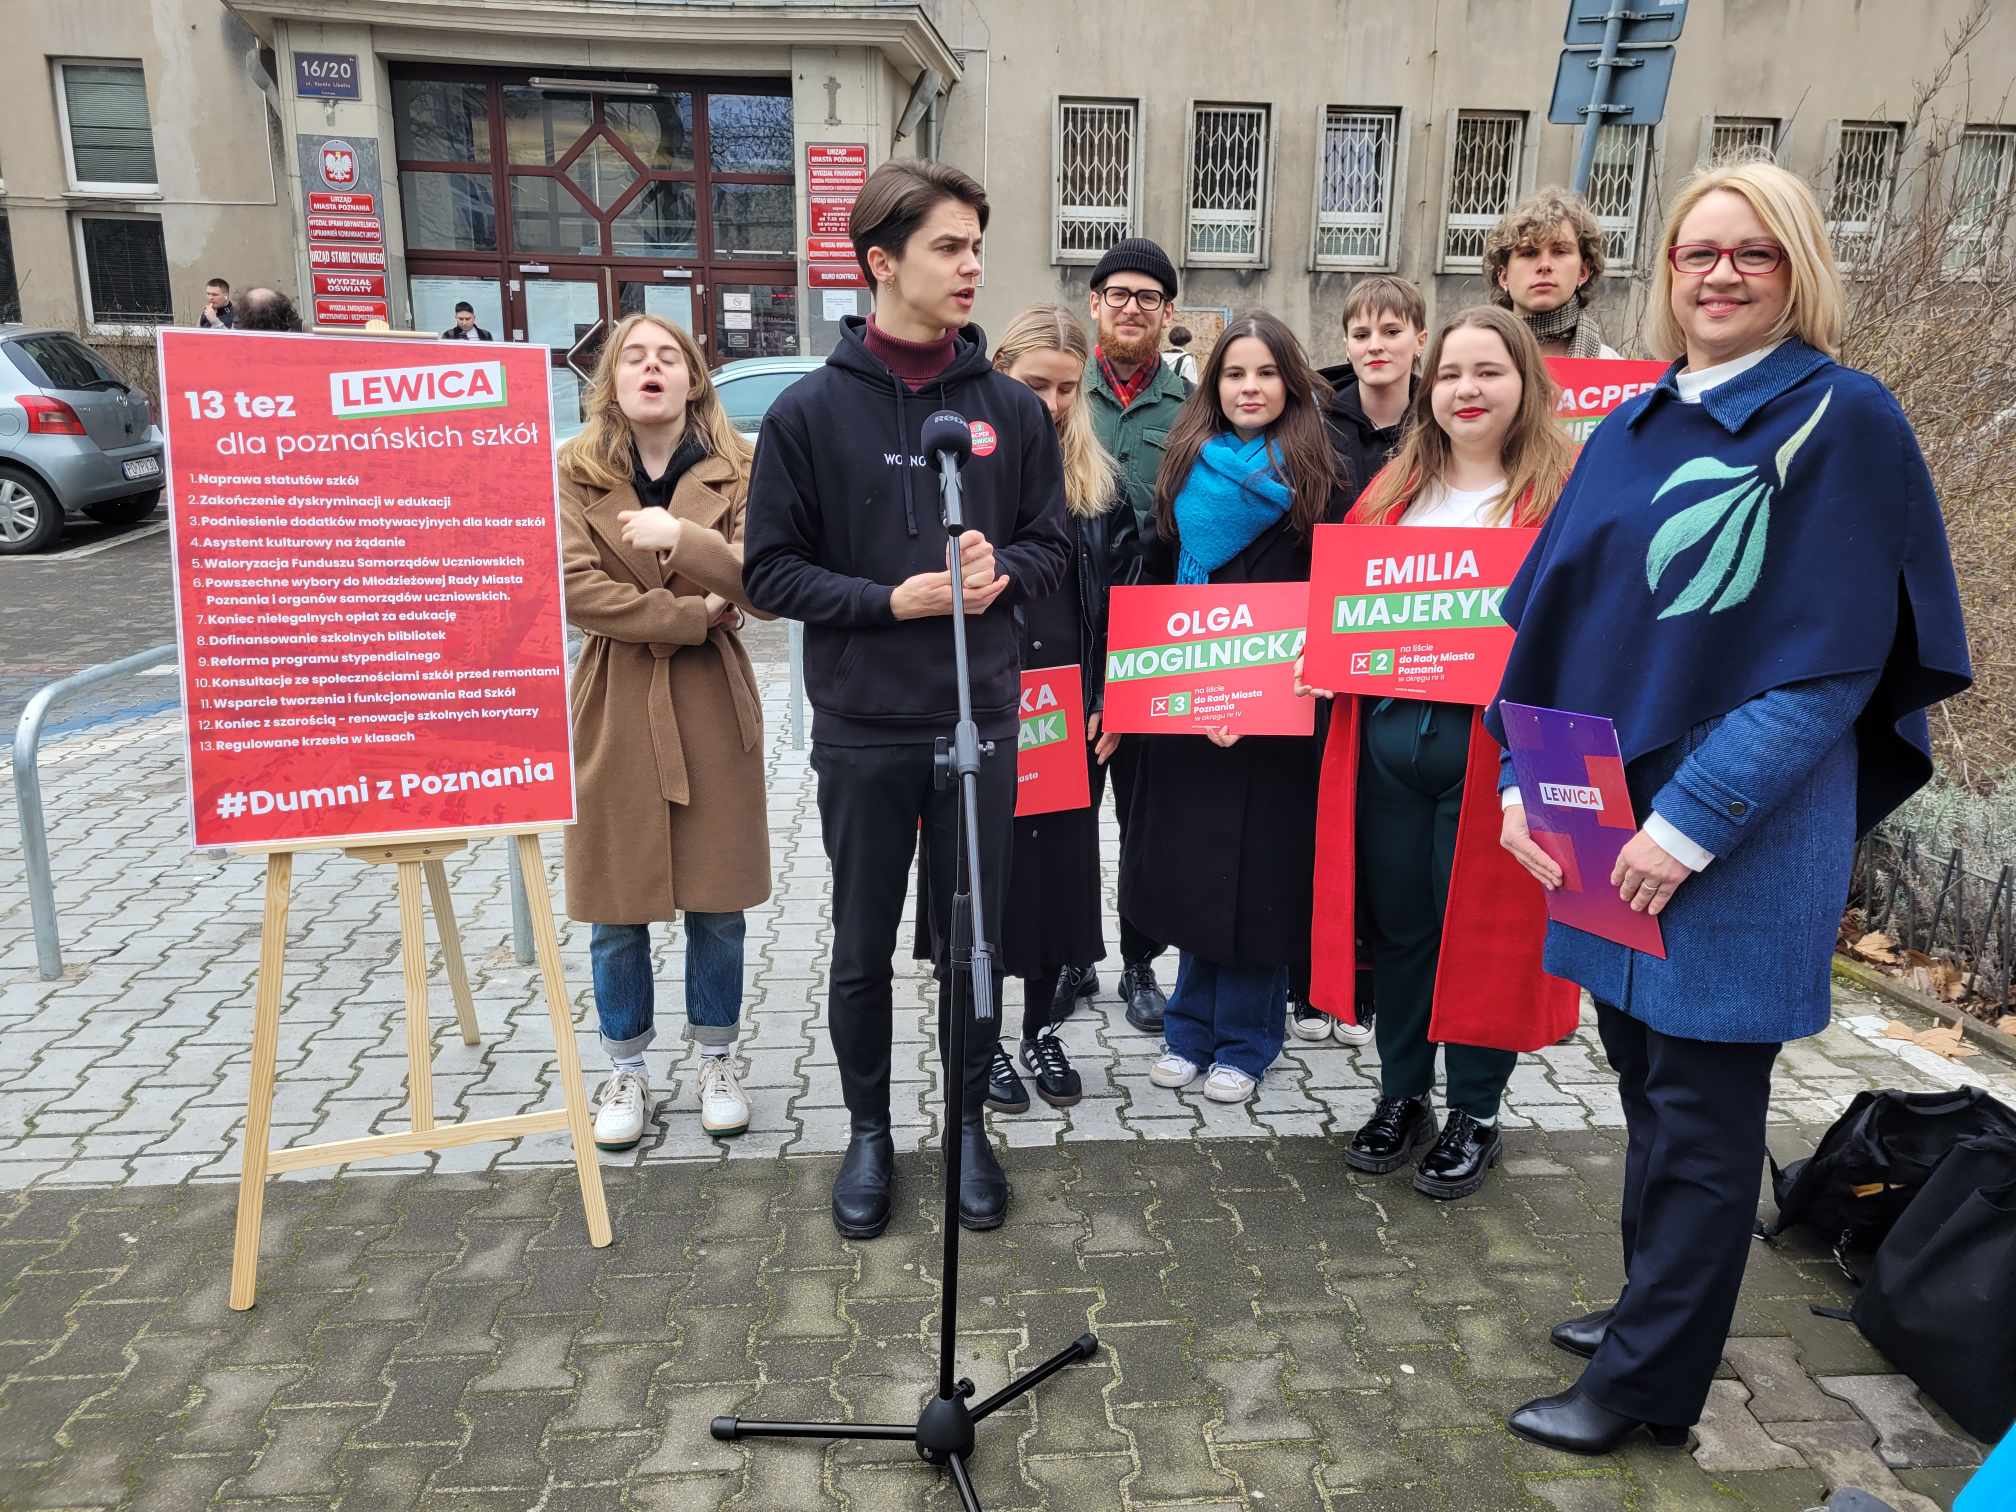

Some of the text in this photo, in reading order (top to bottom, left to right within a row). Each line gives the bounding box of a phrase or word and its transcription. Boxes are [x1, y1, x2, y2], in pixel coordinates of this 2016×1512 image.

[302, 61, 351, 78] 16/20
[330, 196, 352, 204] URZĄD
[341, 368, 494, 408] LEWICA
[185, 391, 296, 419] 13 tez
[217, 423, 538, 460] dla poznańskich szkół
[199, 474, 261, 486] Naprawa
[264, 475, 323, 485] statutów
[327, 475, 359, 485] szkół
[200, 495, 285, 505] Zakończenie
[288, 496, 381, 508] dyskryminacji
[397, 497, 450, 509] edukacji
[201, 516, 287, 526] Podniesienie
[291, 517, 356, 526] dodatków
[359, 517, 460, 529] motywacyjnych
[463, 518, 482, 526] dla
[485, 518, 512, 526] kadr
[515, 517, 545, 526] szkół
[203, 538, 263, 550] Asystent
[266, 538, 332, 549] kulturowy
[355, 537, 405, 549] żądanie
[205, 558, 289, 570] Waloryzacja
[292, 558, 354, 567] Funduszu
[358, 557, 439, 568] Samorządów
[442, 557, 524, 566] Uczniowskich
[1366, 550, 1479, 586] EMILIA
[206, 578, 289, 587] Powszechne
[292, 577, 340, 589] wybory
[343, 577, 359, 585] do
[363, 575, 445, 587] Młodzieżowej
[448, 576, 479, 587] Rady
[482, 575, 522, 584] Miasta
[207, 594, 269, 604] Poznania
[279, 593, 337, 606] organów
[340, 592, 422, 604] samorządów
[425, 591, 510, 601] uczniowskich.
[1336, 588, 1505, 628] MAJERYK
[208, 614, 254, 624] Koniec
[258, 613, 343, 625] nielegalnych
[346, 612, 379, 624] opłat
[382, 613, 396, 621] za
[399, 610, 456, 622] edukację
[1167, 604, 1254, 637] OLGA
[209, 633, 318, 645] Dofinansowanie
[321, 632, 385, 644] szkolnych
[388, 631, 445, 640] blibliotek
[211, 656, 269, 666] Reforma
[272, 656, 338, 667] programu
[342, 651, 440, 664] stypendialnego
[1108, 632, 1306, 679] MOGILNICKA
[1376, 653, 1388, 670] 2
[1400, 652, 1475, 664] do Rady Miasta
[212, 675, 292, 688] Konsultacje
[312, 671, 419, 686] społecznościami
[422, 670, 453, 680] szkół
[456, 669, 490, 681] przed
[493, 666, 559, 677] remontami
[1399, 665, 1443, 674] Poznania
[214, 696, 277, 710] Wsparcie
[281, 694, 345, 705] tworzenia
[354, 690, 455, 704] funkcjonowania
[459, 689, 481, 698] Rad
[484, 688, 515, 697] Szkół
[1174, 697, 1185, 711] 3
[1194, 690, 1263, 704] do Rady Miasta
[1194, 703, 1234, 713] Poznania
[215, 718, 260, 729] Koniec
[273, 715, 336, 726] szarością
[349, 712, 415, 724] renowacje
[418, 709, 479, 721] szkolnych
[482, 708, 539, 719] korytarzy
[216, 739, 299, 752] Regulowane
[302, 735, 348, 745] krzesła
[365, 732, 415, 743] klasach
[217, 758, 554, 818] #Dumni z Poznania
[1544, 786, 1600, 806] LEWICA
